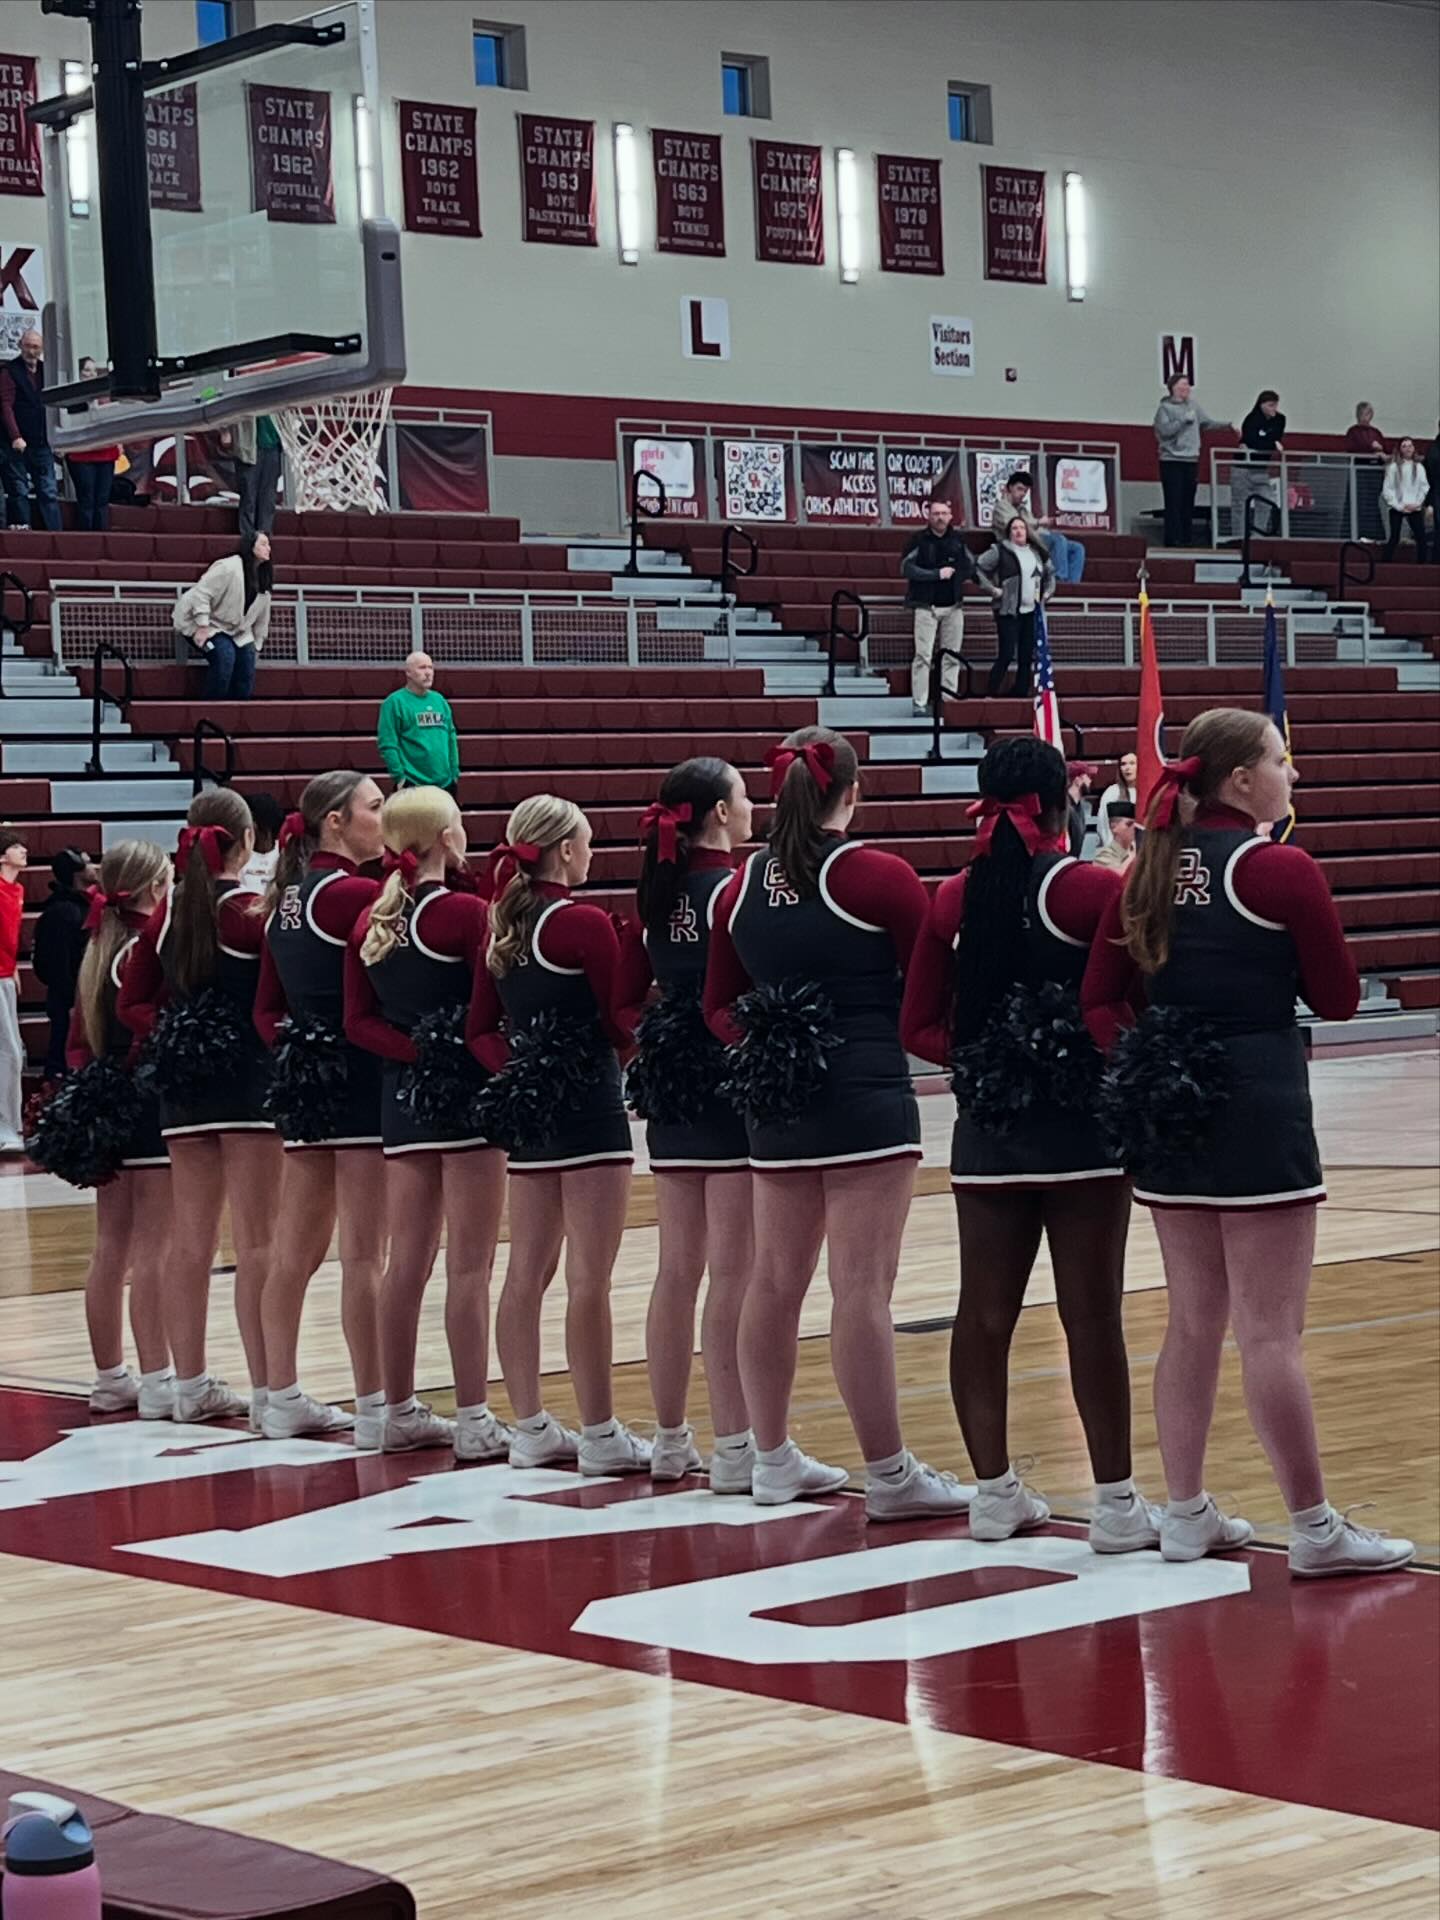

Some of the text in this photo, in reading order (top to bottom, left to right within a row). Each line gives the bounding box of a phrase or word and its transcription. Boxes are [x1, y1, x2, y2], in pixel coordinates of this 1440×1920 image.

[145, 103, 194, 127] AMPS
[265, 97, 314, 121] STATE
[411, 111, 465, 134] STATE
[147, 128, 176, 149] 961
[258, 125, 324, 149] CHAMPS
[405, 132, 473, 157] CHAMPS
[534, 126, 583, 148] STATE
[526, 146, 591, 170] CHAMPS
[663, 138, 711, 160] STATE
[148, 153, 175, 169] OYS
[273, 153, 313, 175] 1962
[420, 158, 460, 179] 1962
[657, 159, 719, 182] CHAMPS
[766, 150, 813, 173] STATE
[541, 171, 579, 192] 1963
[760, 173, 817, 195] CHAMPS
[888, 165, 931, 184] STATE
[267, 182, 321, 199] FOOTBALL
[426, 181, 457, 197] BOYS
[672, 183, 707, 202] 1963
[881, 184, 938, 204] CHAMPS
[995, 175, 1038, 197] STATE
[421, 198, 461, 214] TRACK
[546, 193, 576, 209] BOYS
[677, 204, 704, 219] BOYS
[774, 201, 808, 219] 1975
[989, 197, 1042, 218] CHAMPS
[528, 207, 595, 228] BASKETBALL
[765, 225, 816, 243] FOOTBALL
[0, 246, 40, 311] K
[690, 300, 721, 357] L
[932, 322, 971, 345] Visitors
[934, 345, 971, 369] Section
[1162, 335, 1195, 386] M
[830, 451, 856, 470] SCAN
[857, 452, 876, 471] THE
[904, 454, 931, 474] CODE
[842, 474, 933, 497] ACCESS THE NEW
[805, 495, 832, 515] ORHS
[832, 497, 880, 518] ATHLETICS
[890, 500, 922, 519] MEDIA
